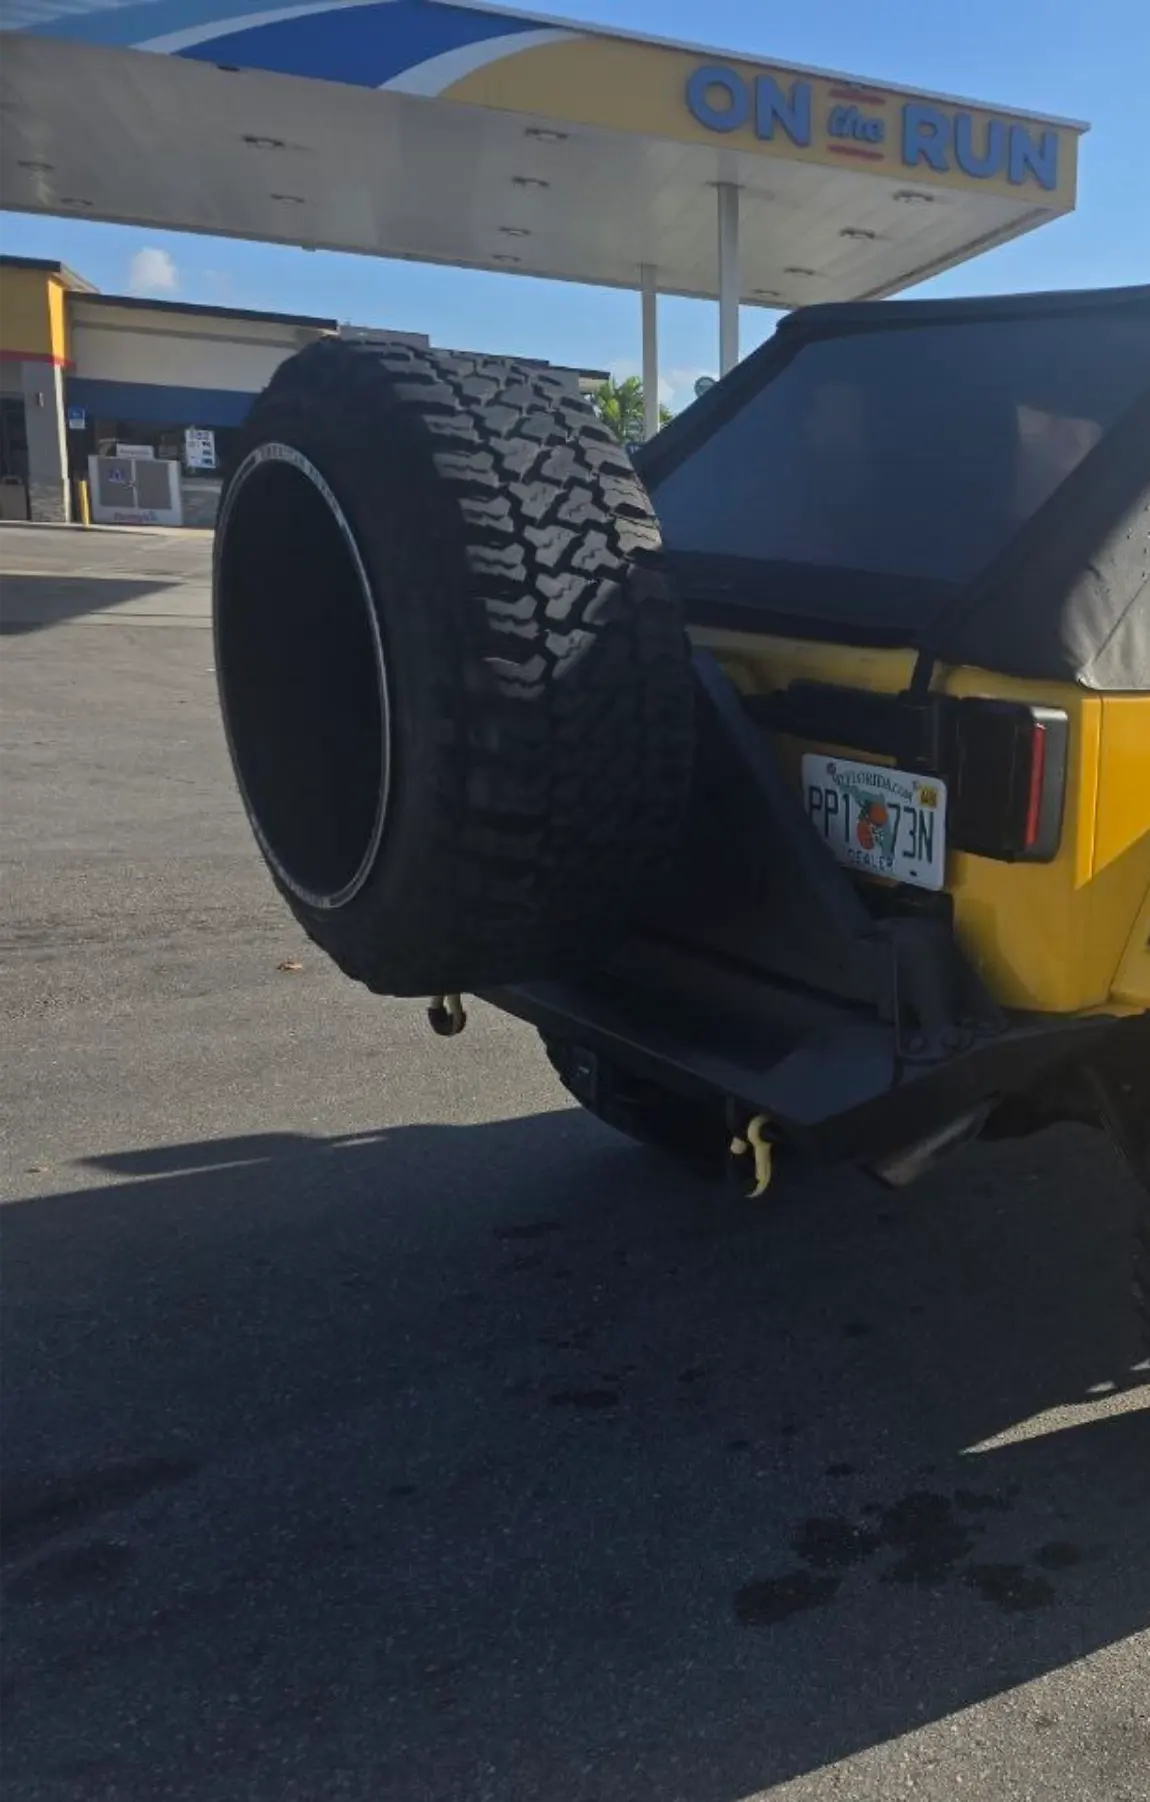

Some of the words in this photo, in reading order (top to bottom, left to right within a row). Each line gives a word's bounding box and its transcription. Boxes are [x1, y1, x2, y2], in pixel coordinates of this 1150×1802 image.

[685, 63, 812, 148] ON
[826, 103, 885, 144] the
[902, 104, 1059, 191] RUN
[848, 848, 896, 873] DEALER
[887, 802, 934, 864] 73N
